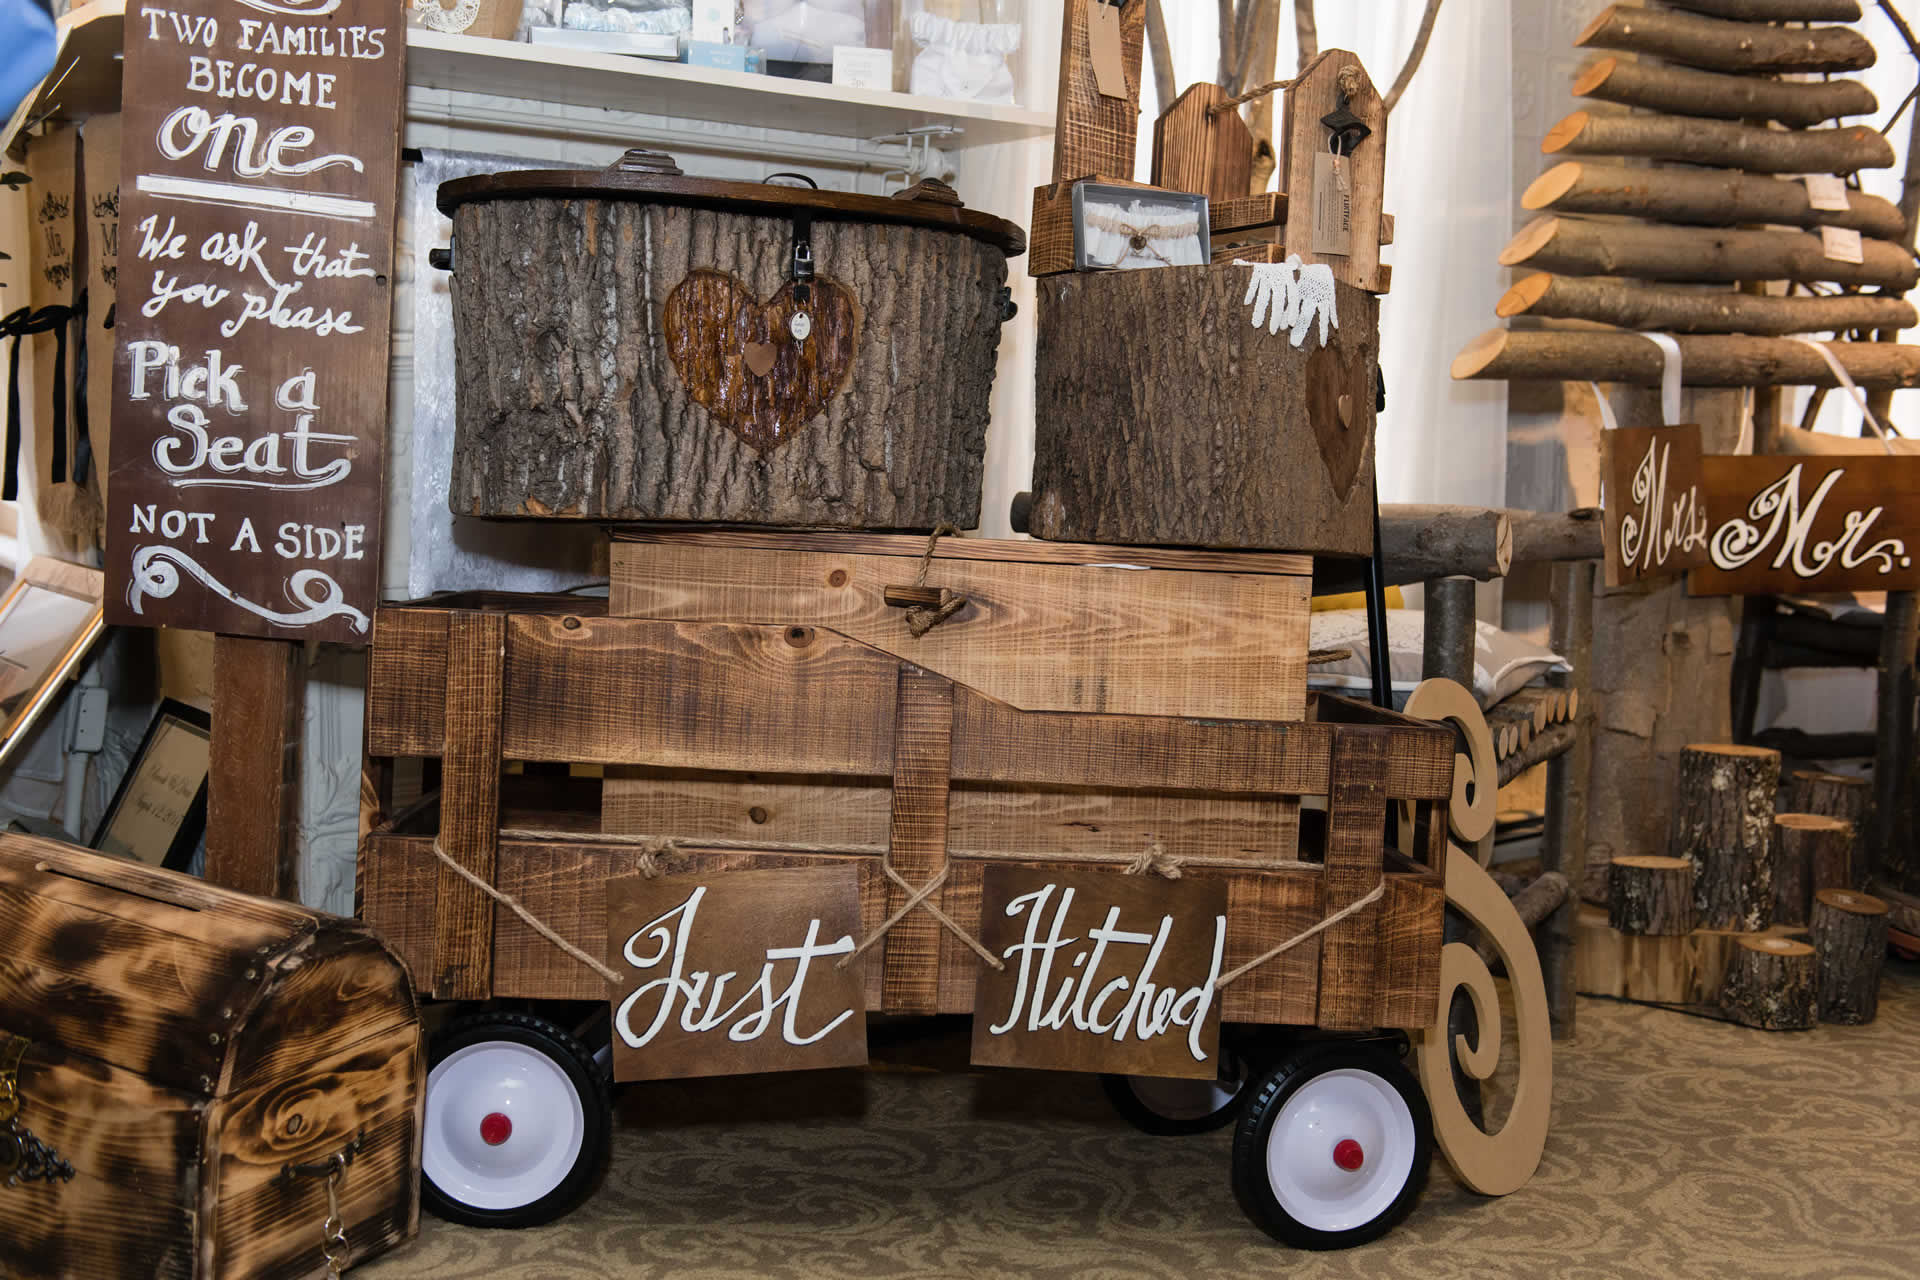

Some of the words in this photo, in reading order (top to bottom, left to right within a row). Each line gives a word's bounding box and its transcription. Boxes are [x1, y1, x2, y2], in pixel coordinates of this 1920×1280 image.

[140, 7, 218, 48] TWO
[238, 18, 387, 60] FAMILIES
[186, 55, 337, 110] BECOME
[138, 214, 188, 261] We
[200, 220, 281, 291] ask
[284, 232, 377, 278] that
[141, 270, 231, 318] you
[220, 280, 365, 338] please
[126, 340, 249, 416] Pick
[275, 366, 320, 412] a
[152, 404, 358, 490] Seat
[129, 503, 216, 544] NOT
[230, 517, 262, 554] A
[274, 521, 366, 561] SIDE
[615, 886, 856, 1048] Just
[989, 883, 1227, 1061] Hitched
